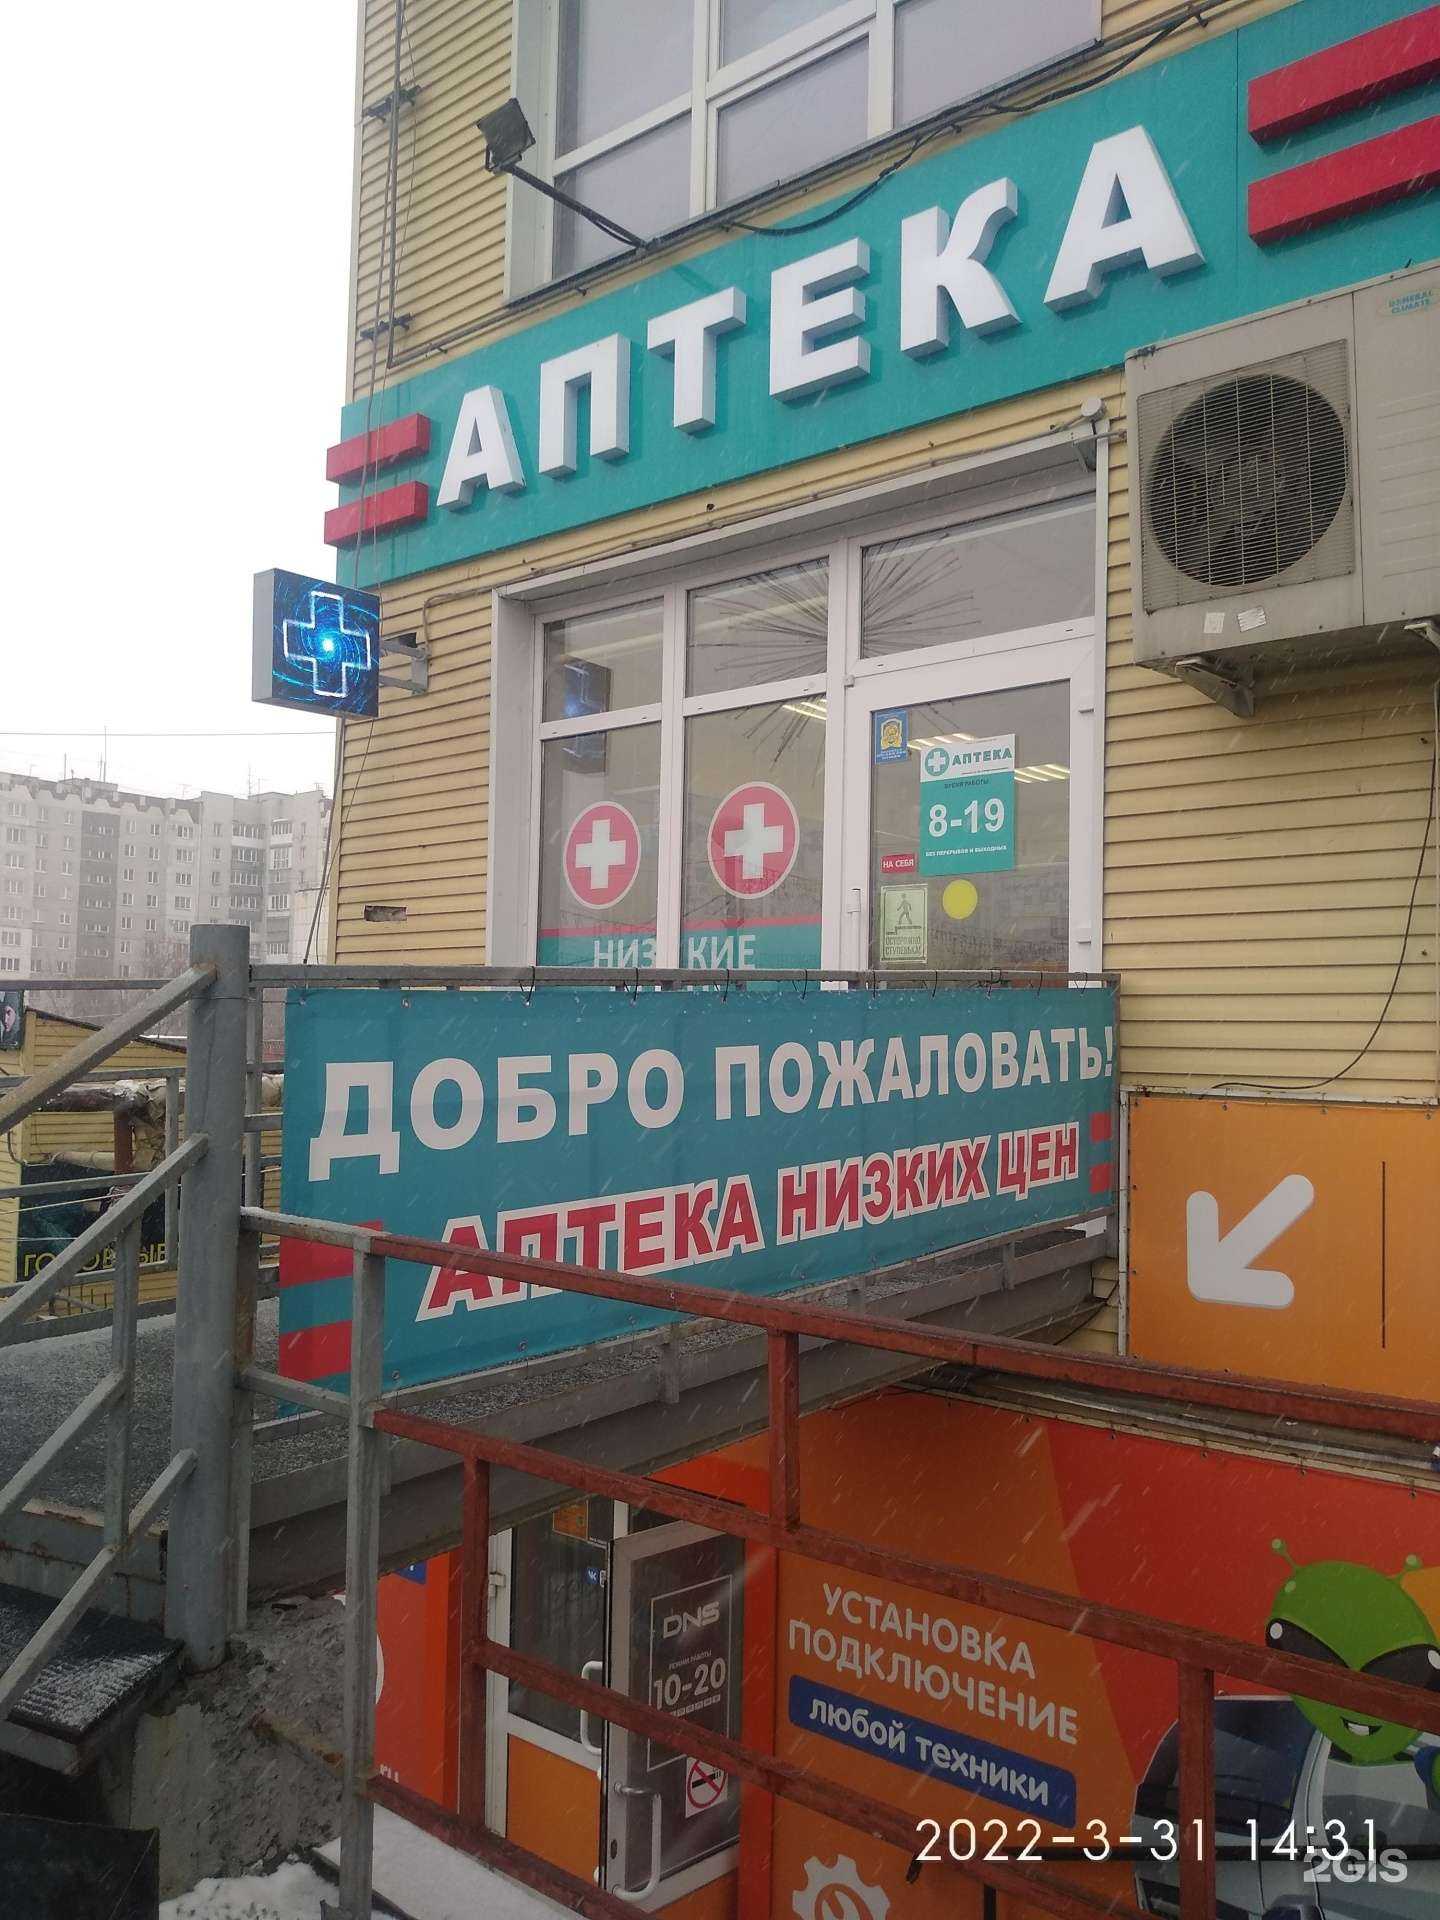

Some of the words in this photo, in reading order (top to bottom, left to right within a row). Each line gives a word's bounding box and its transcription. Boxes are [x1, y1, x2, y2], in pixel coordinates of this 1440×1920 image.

[436, 124, 1207, 509] АПТЕКА
[952, 747, 1013, 766] АПТЕКА
[883, 860, 893, 869] НА
[895, 859, 914, 868] СЕБЯ
[928, 798, 1005, 837] 8-19
[308, 1049, 685, 1182] ДОБРО
[715, 1026, 1113, 1120] ПОЖАЛОВАТЬ!
[415, 1174, 765, 1322] АПТЕКА
[776, 1135, 991, 1245] НИЗКИХ
[997, 1121, 1080, 1201] ЦЕН
[663, 1601, 720, 1639] DNS
[823, 1583, 1035, 1680] УСТАНОВКА
[654, 1658, 726, 1711] 10-20
[789, 1619, 1078, 1745] ПОДКЛЮЧЕНИЕ
[809, 1699, 906, 1753] любой
[915, 1736, 1048, 1806] техники
